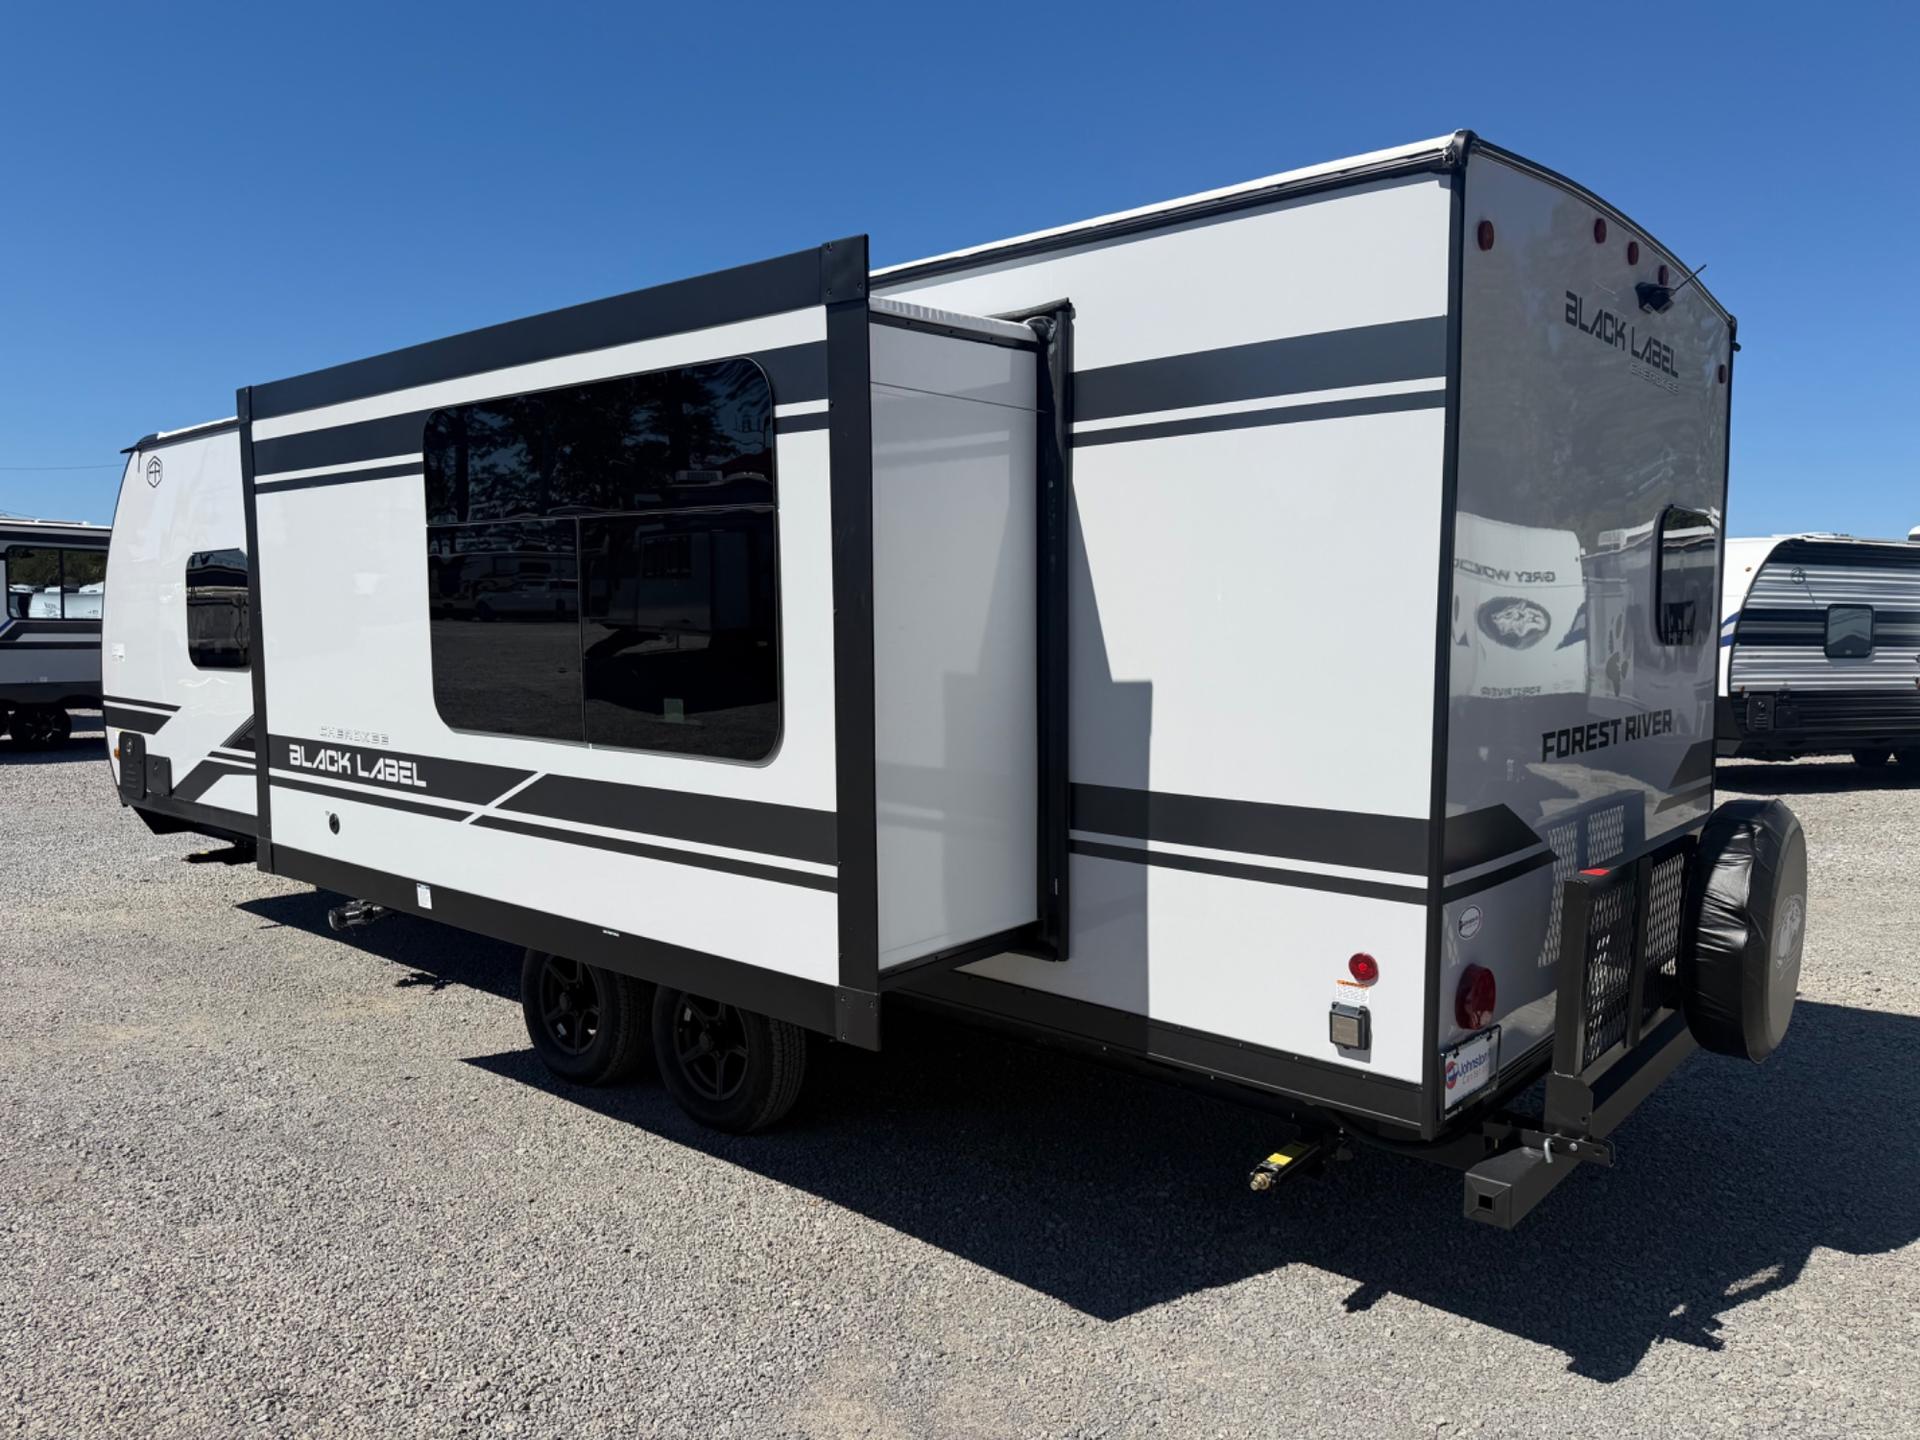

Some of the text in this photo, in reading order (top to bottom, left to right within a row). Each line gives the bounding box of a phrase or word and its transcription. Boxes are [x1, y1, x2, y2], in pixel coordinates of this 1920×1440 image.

[1565, 290, 1679, 378] BLACK LABEL
[1541, 709, 1672, 763] FOREST RIVER
[289, 743, 427, 788] BLACK LABEL
